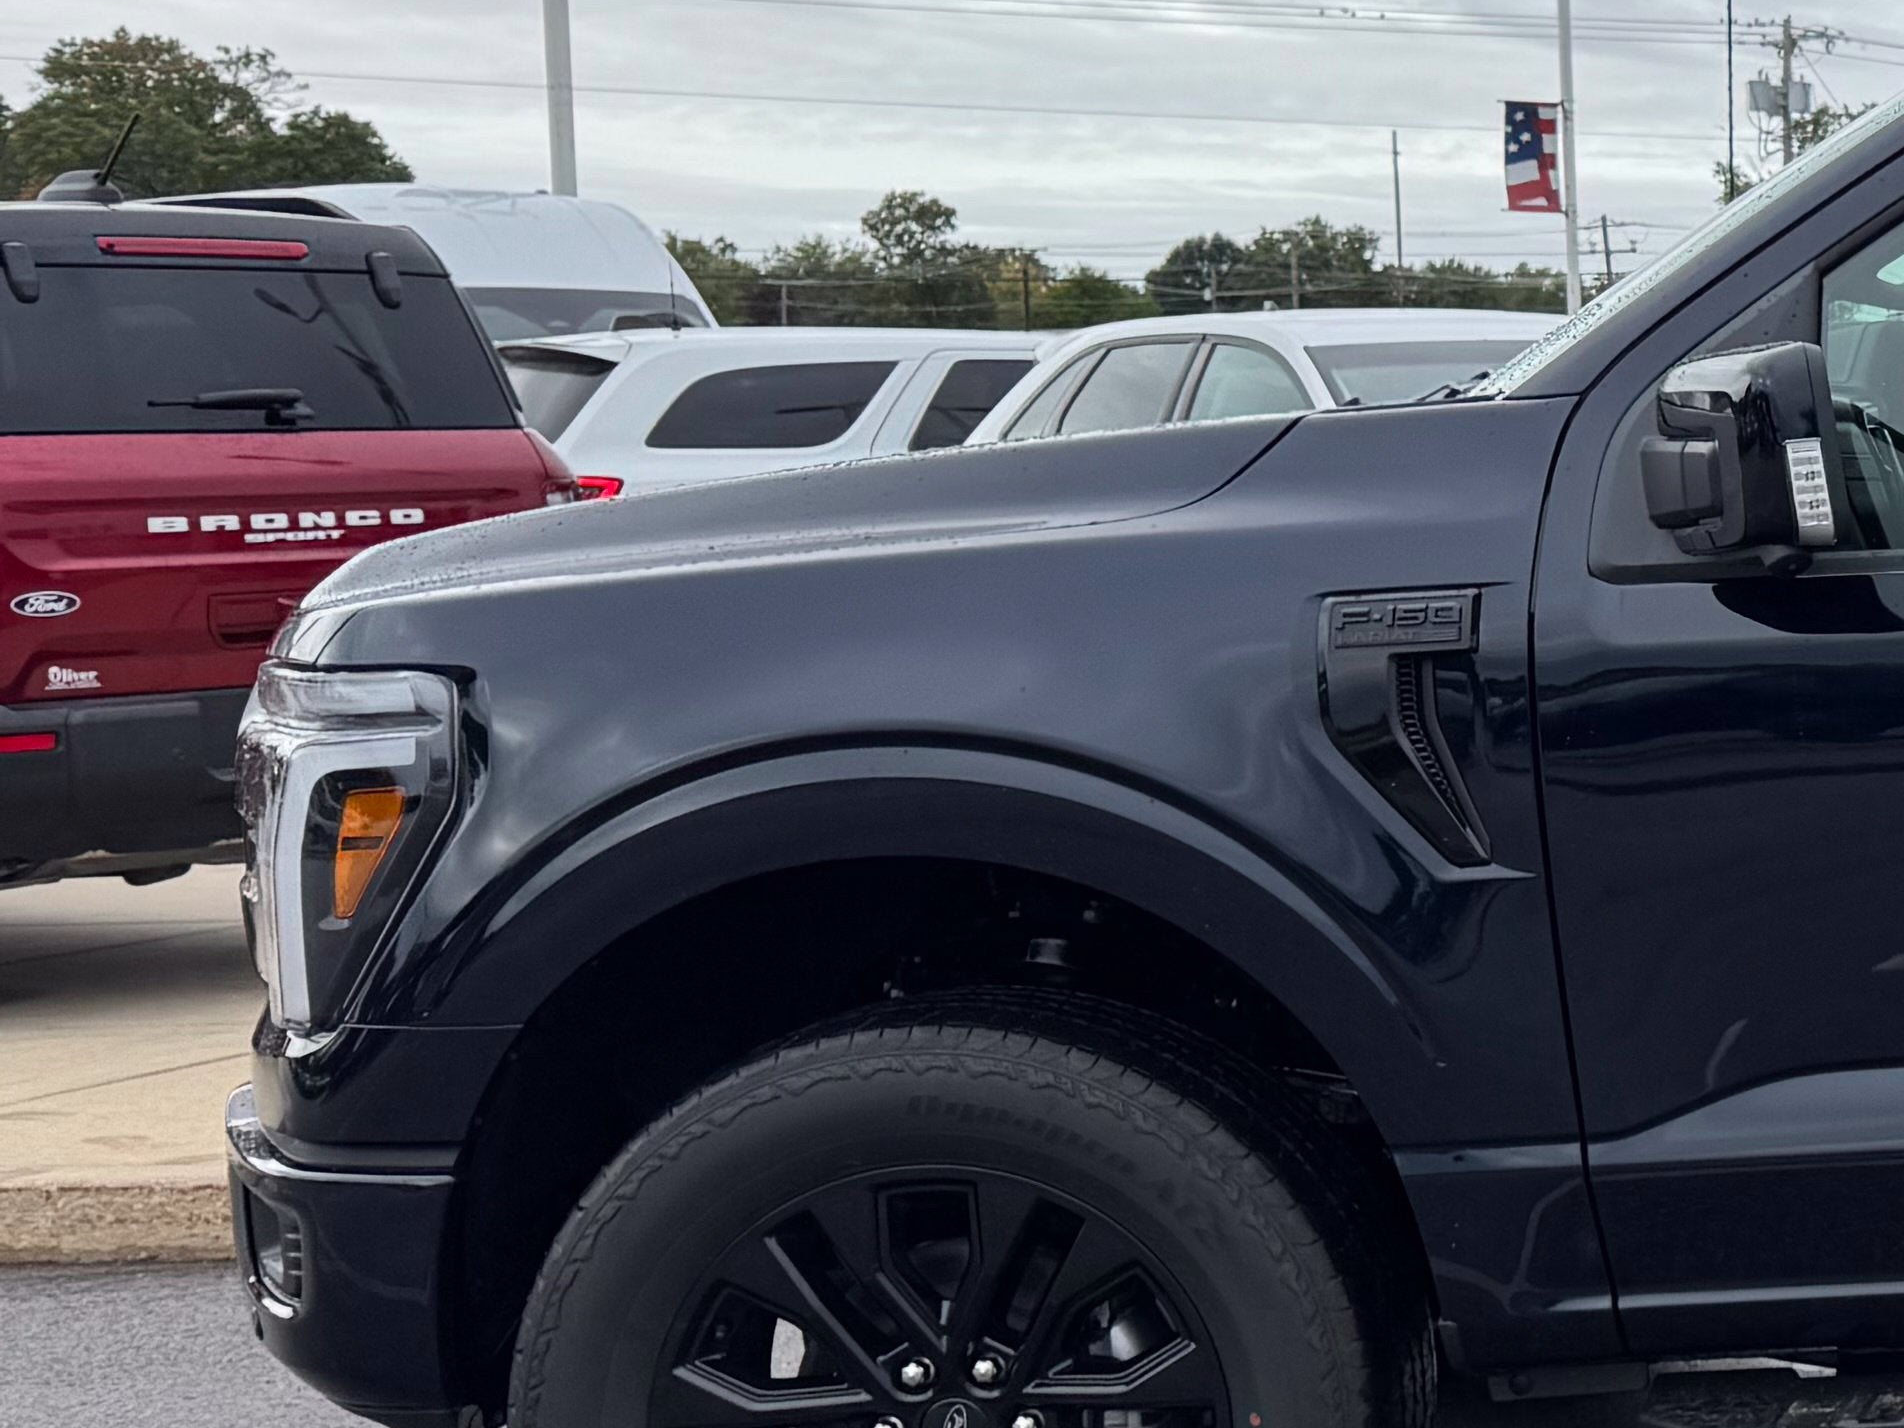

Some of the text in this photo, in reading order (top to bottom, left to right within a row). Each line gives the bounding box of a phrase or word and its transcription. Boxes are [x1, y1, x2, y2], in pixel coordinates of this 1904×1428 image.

[147, 508, 425, 534] BRONCO
[244, 529, 346, 544] SPORT
[24, 594, 69, 613] Ford
[1334, 601, 1463, 631] F-150
[48, 665, 99, 684] Oliver
